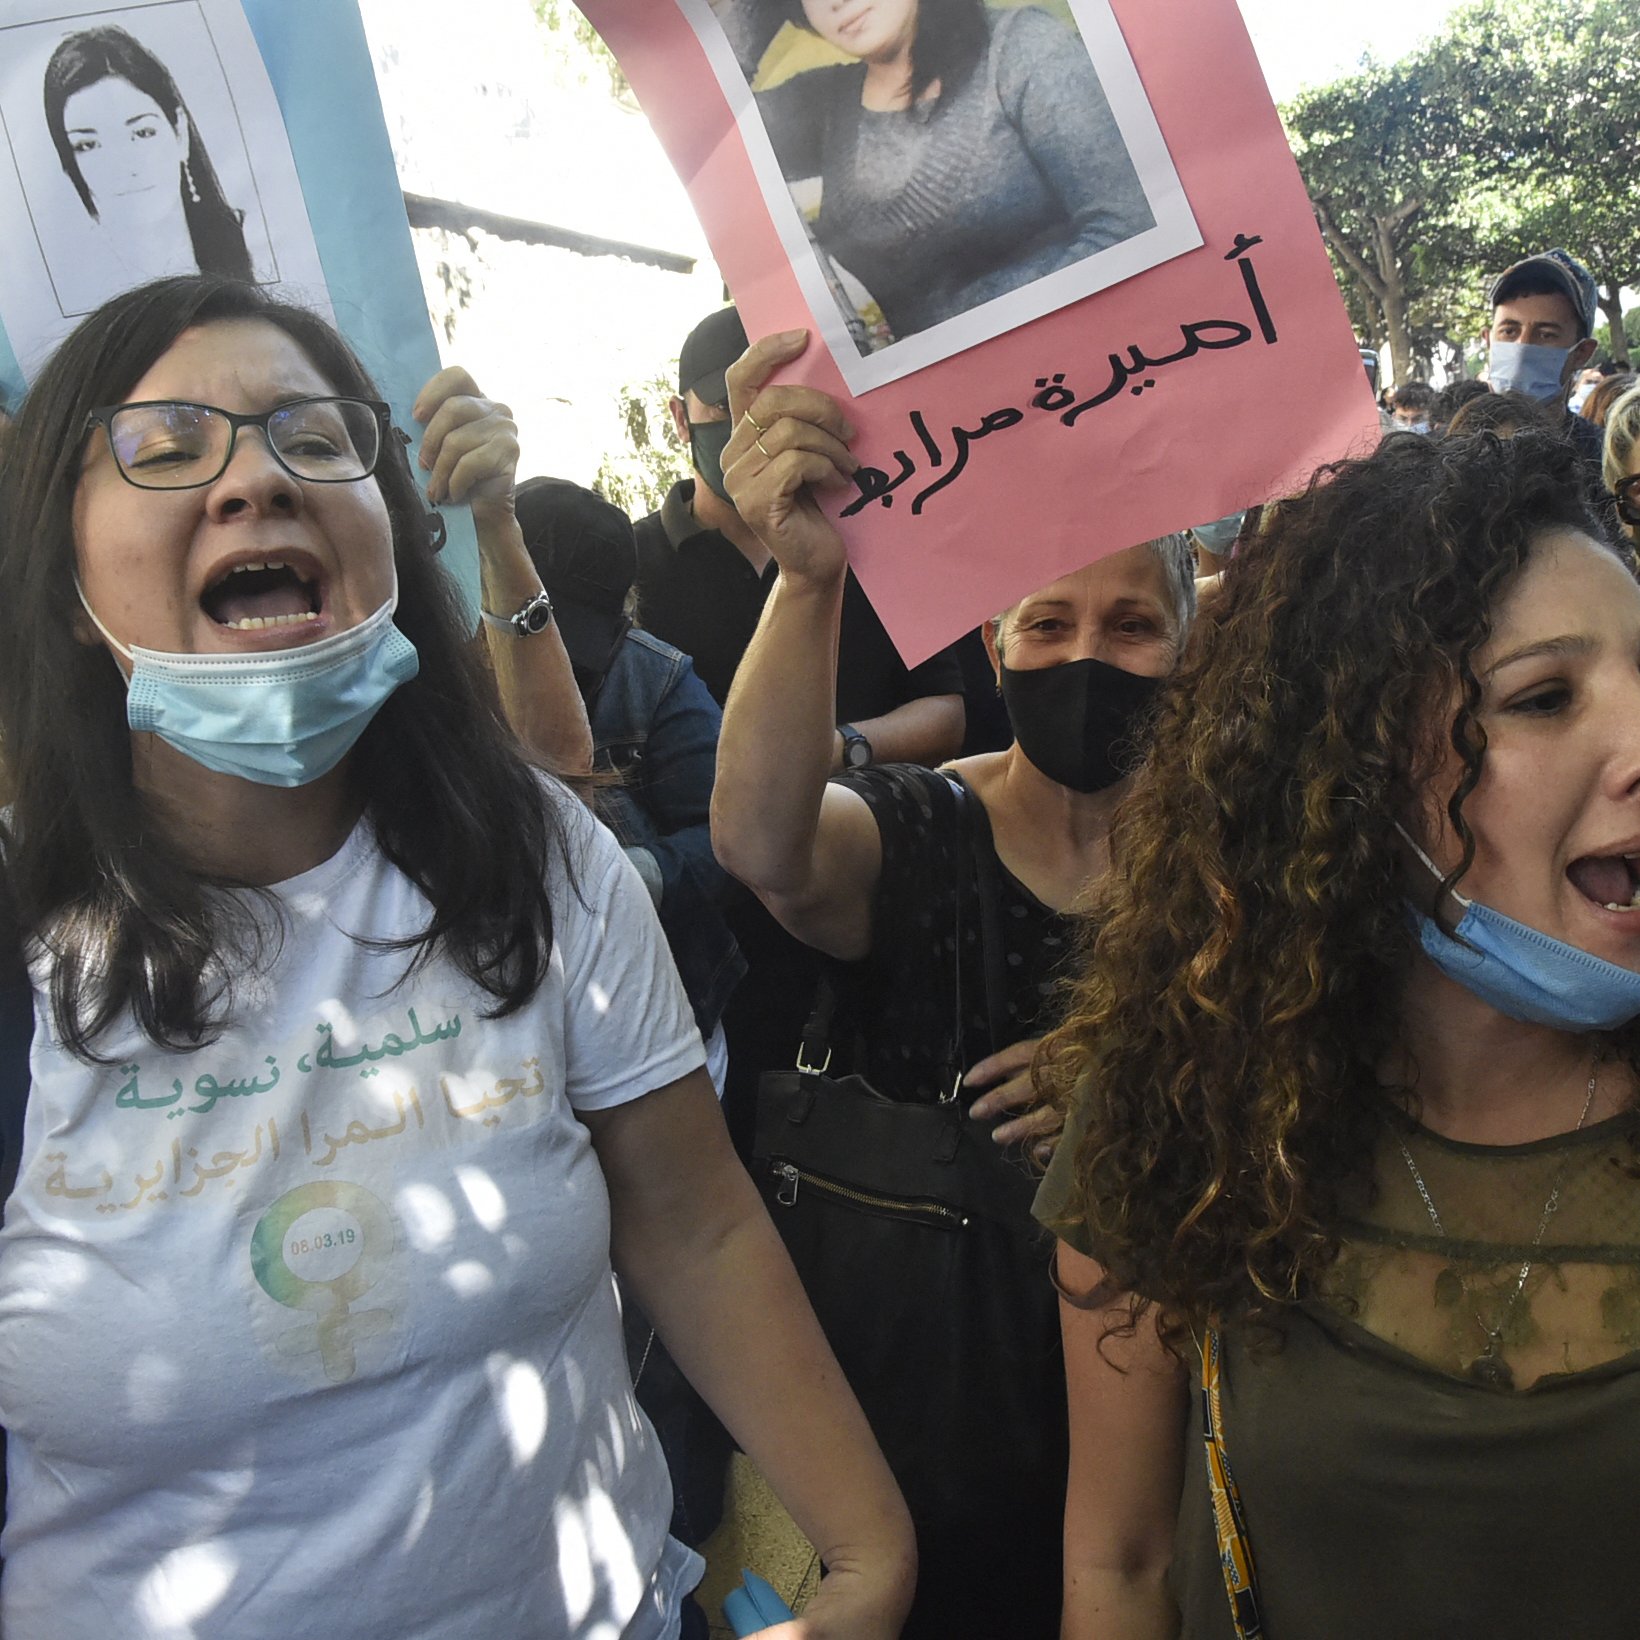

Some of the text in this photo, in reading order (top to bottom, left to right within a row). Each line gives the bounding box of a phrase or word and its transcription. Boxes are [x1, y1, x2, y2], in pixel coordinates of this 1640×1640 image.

[1029, 234, 1277, 427] أميرة
[115, 1007, 462, 1120] سلمية، نسوية
[45, 1056, 545, 1213] تحيا المرا الجزايرية
[290, 1228, 356, 1256] 08.03.19
